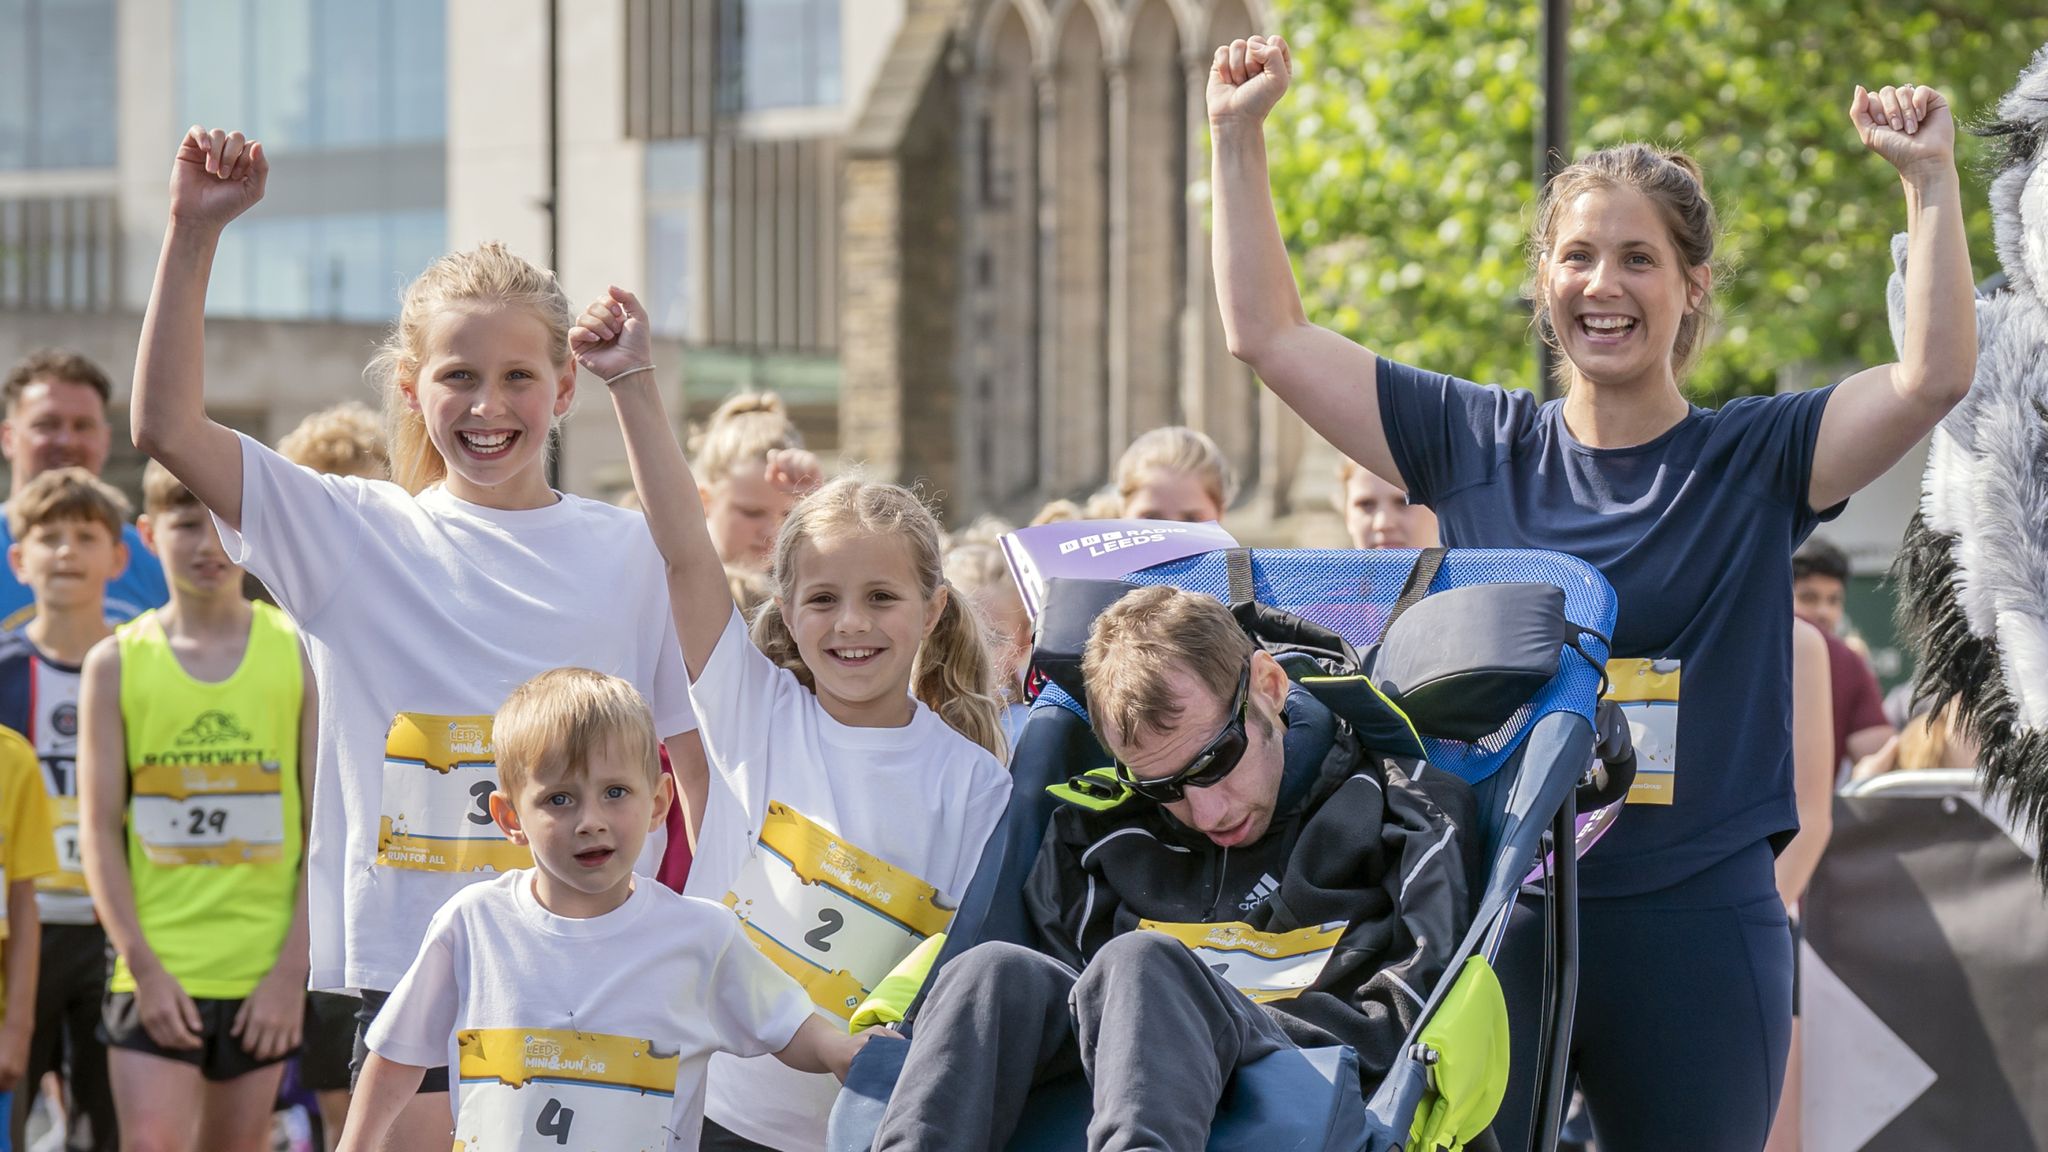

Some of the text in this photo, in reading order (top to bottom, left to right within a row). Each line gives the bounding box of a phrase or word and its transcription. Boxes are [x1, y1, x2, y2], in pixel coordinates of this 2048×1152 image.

[1127, 528, 1187, 537] RADIO
[1088, 534, 1166, 558] LEEDS
[450, 729, 483, 741] LEEDS
[467, 780, 497, 825] 3
[189, 807, 228, 836] 29
[388, 852, 446, 865] RUN FOR ALL
[804, 908, 844, 953] 2
[525, 1043, 562, 1056] LEEDS
[535, 1098, 575, 1145] 4
